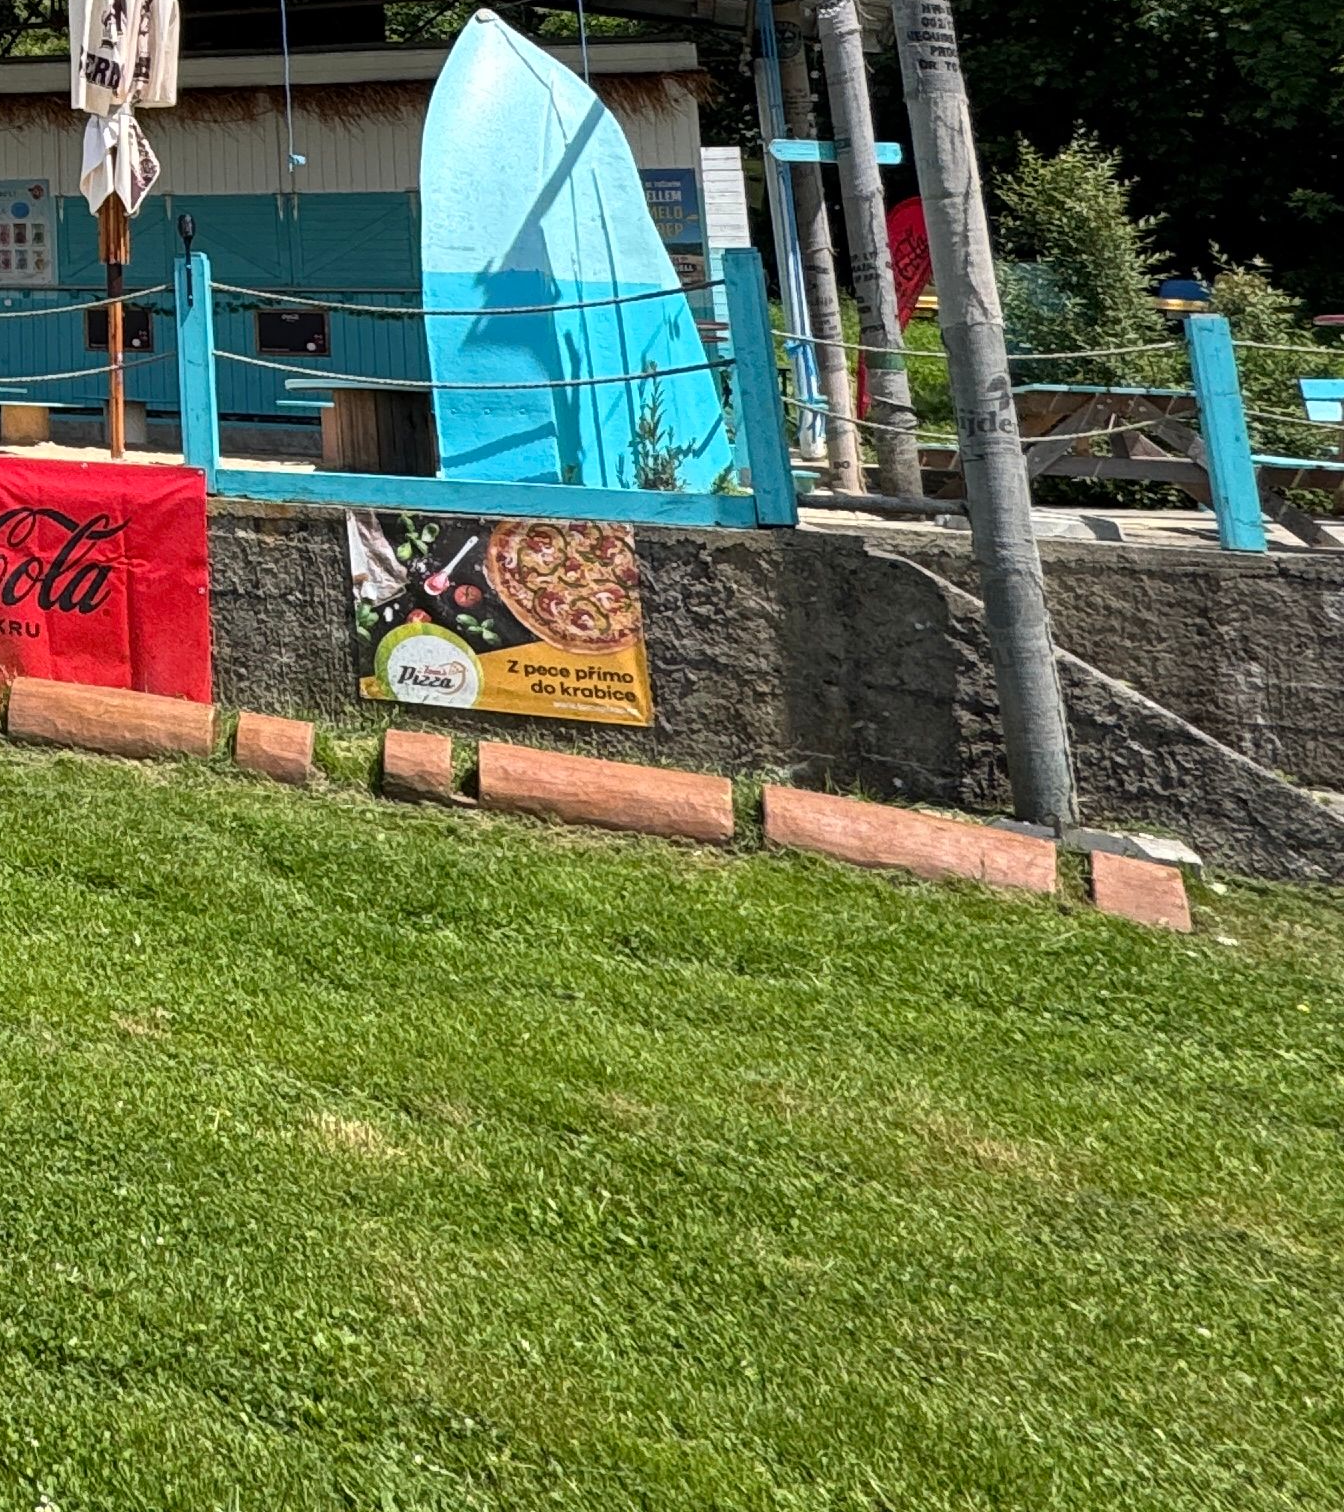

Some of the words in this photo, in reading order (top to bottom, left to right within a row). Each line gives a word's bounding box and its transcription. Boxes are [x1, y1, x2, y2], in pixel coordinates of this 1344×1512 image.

[397, 665, 456, 688] Pizza
[506, 659, 520, 674] Z
[523, 663, 571, 678] pece
[530, 679, 556, 695] do
[559, 681, 637, 703] krabice
